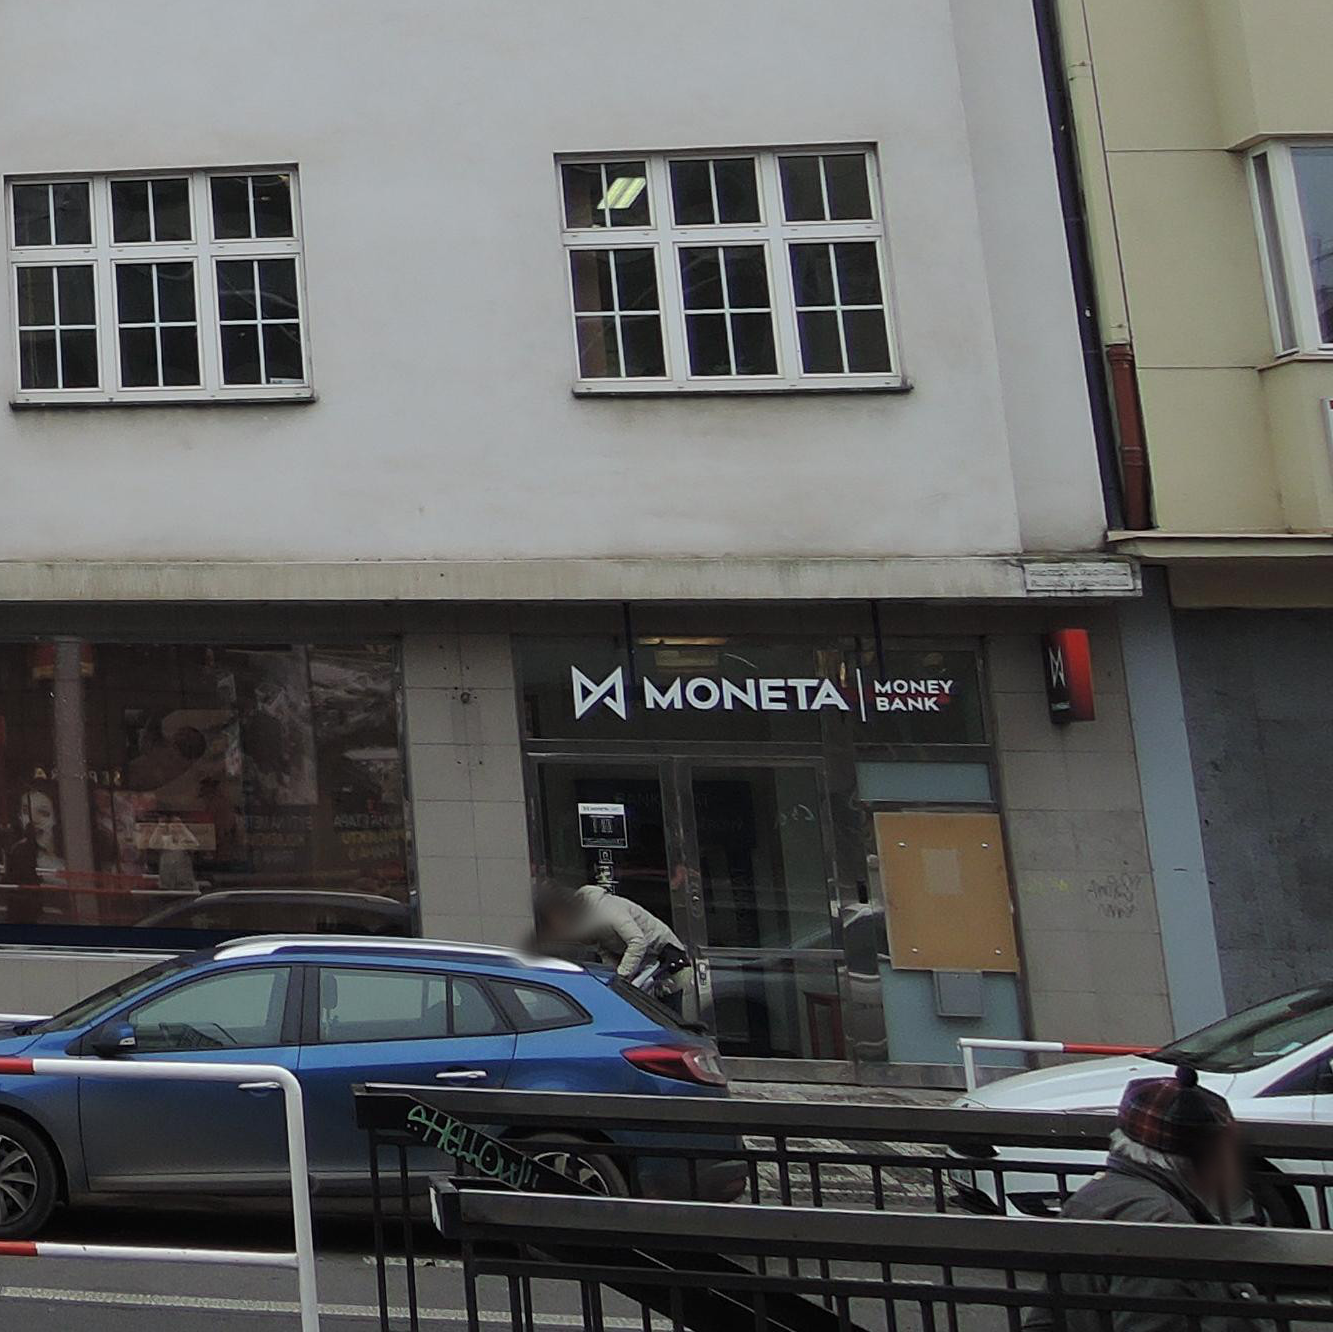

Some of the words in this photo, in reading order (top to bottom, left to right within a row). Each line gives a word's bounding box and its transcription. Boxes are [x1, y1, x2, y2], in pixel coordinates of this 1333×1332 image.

[643, 676, 850, 711] MONETA
[873, 678, 955, 695] MONEY
[876, 695, 941, 712] BANK
